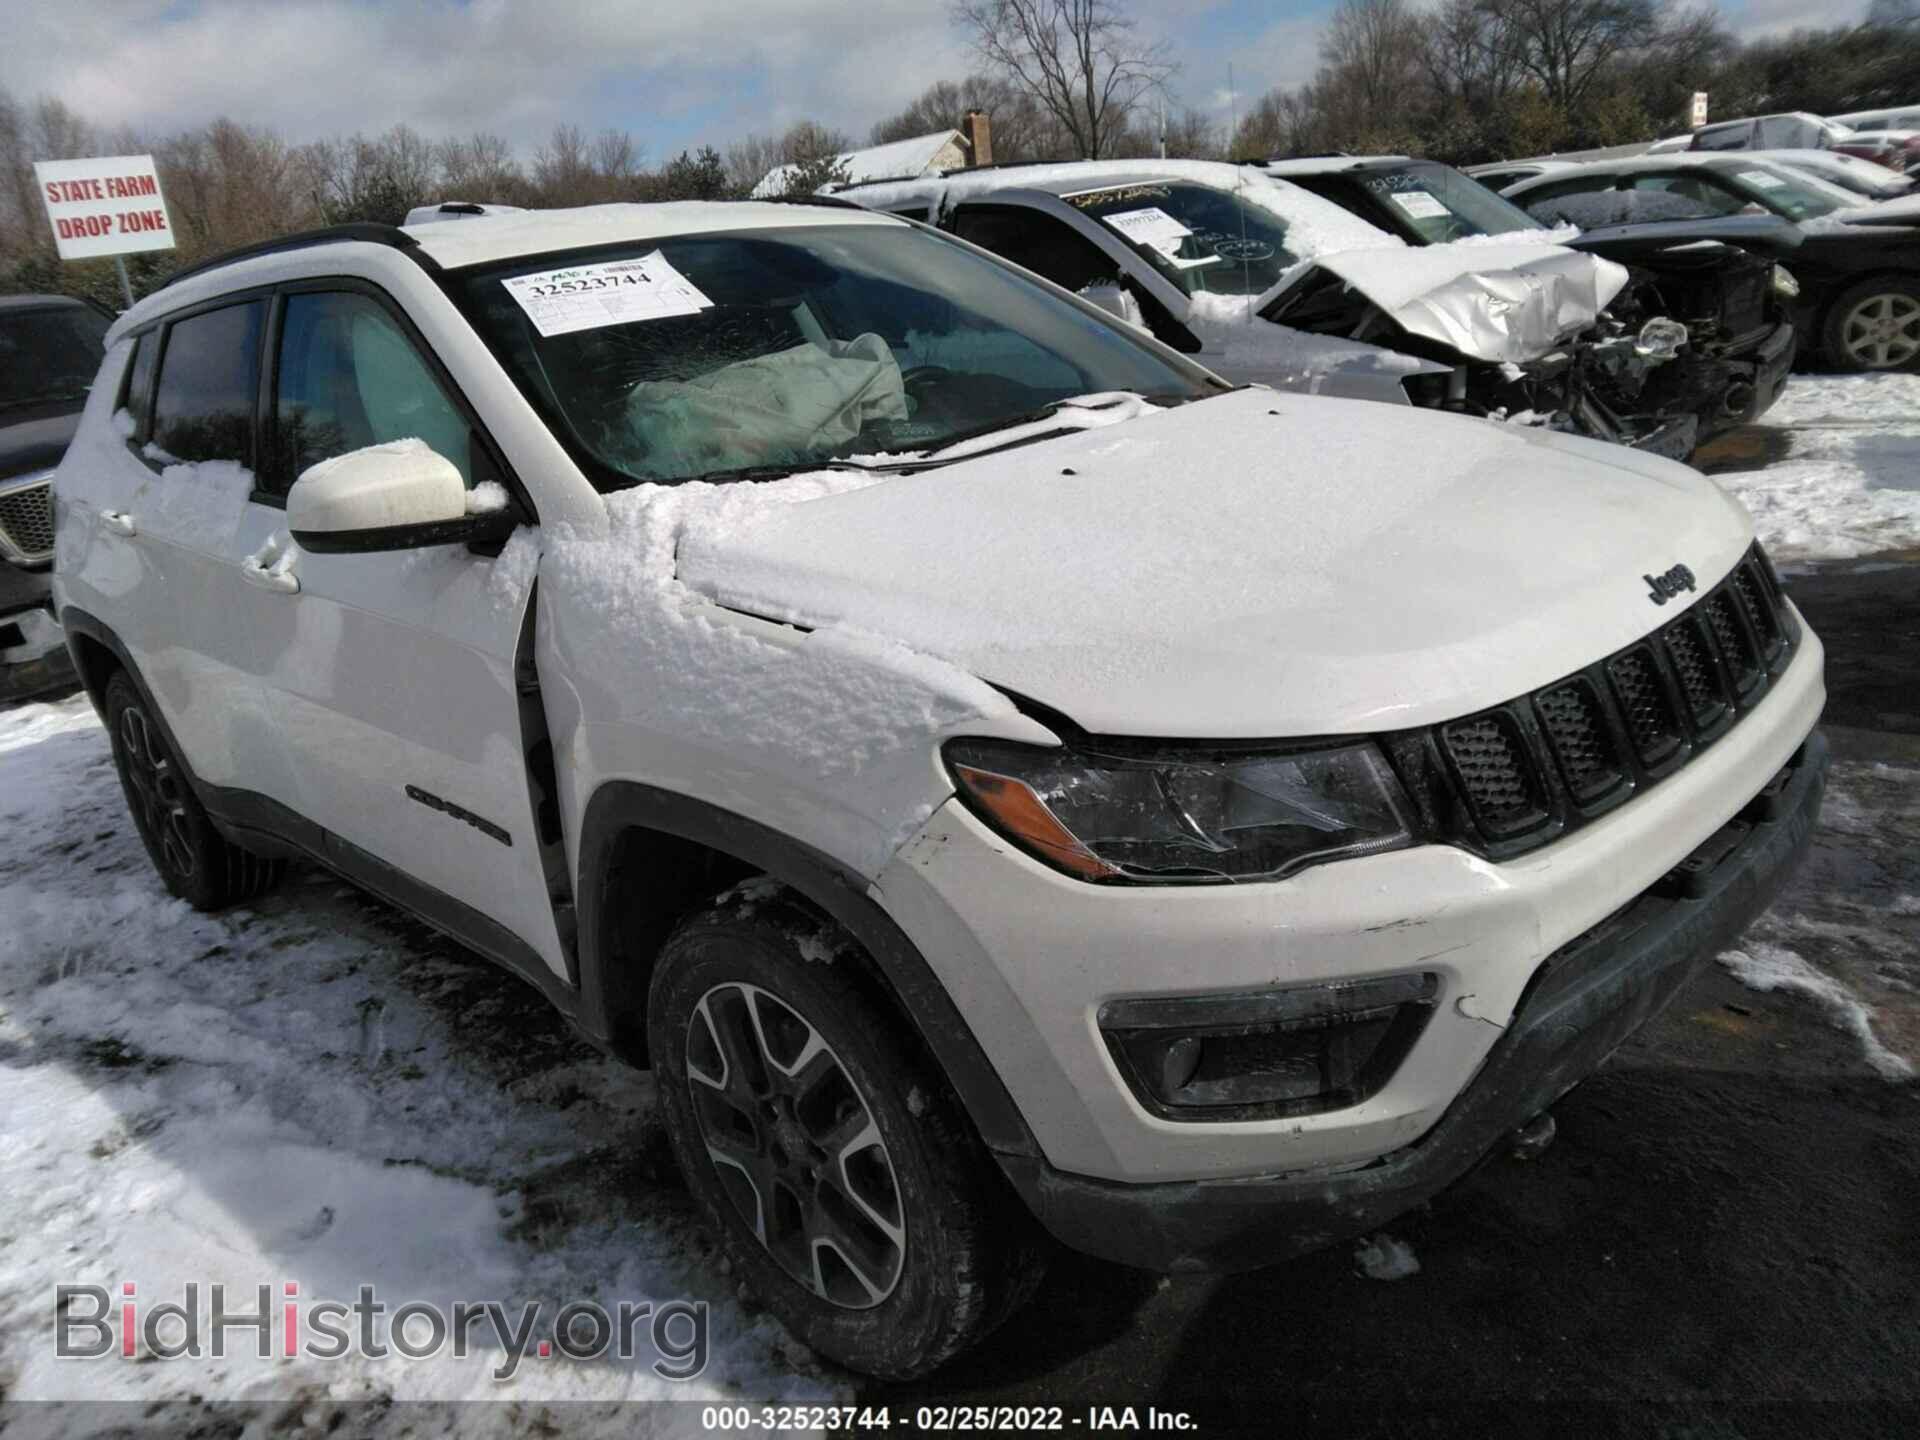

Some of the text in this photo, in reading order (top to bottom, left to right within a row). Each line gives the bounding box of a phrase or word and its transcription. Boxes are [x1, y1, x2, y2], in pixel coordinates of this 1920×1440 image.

[46, 175, 157, 203] STATE FARM
[56, 210, 166, 239] DROP ZONE
[528, 273, 652, 298] 32523744
[1642, 562, 1697, 606] Jeep
